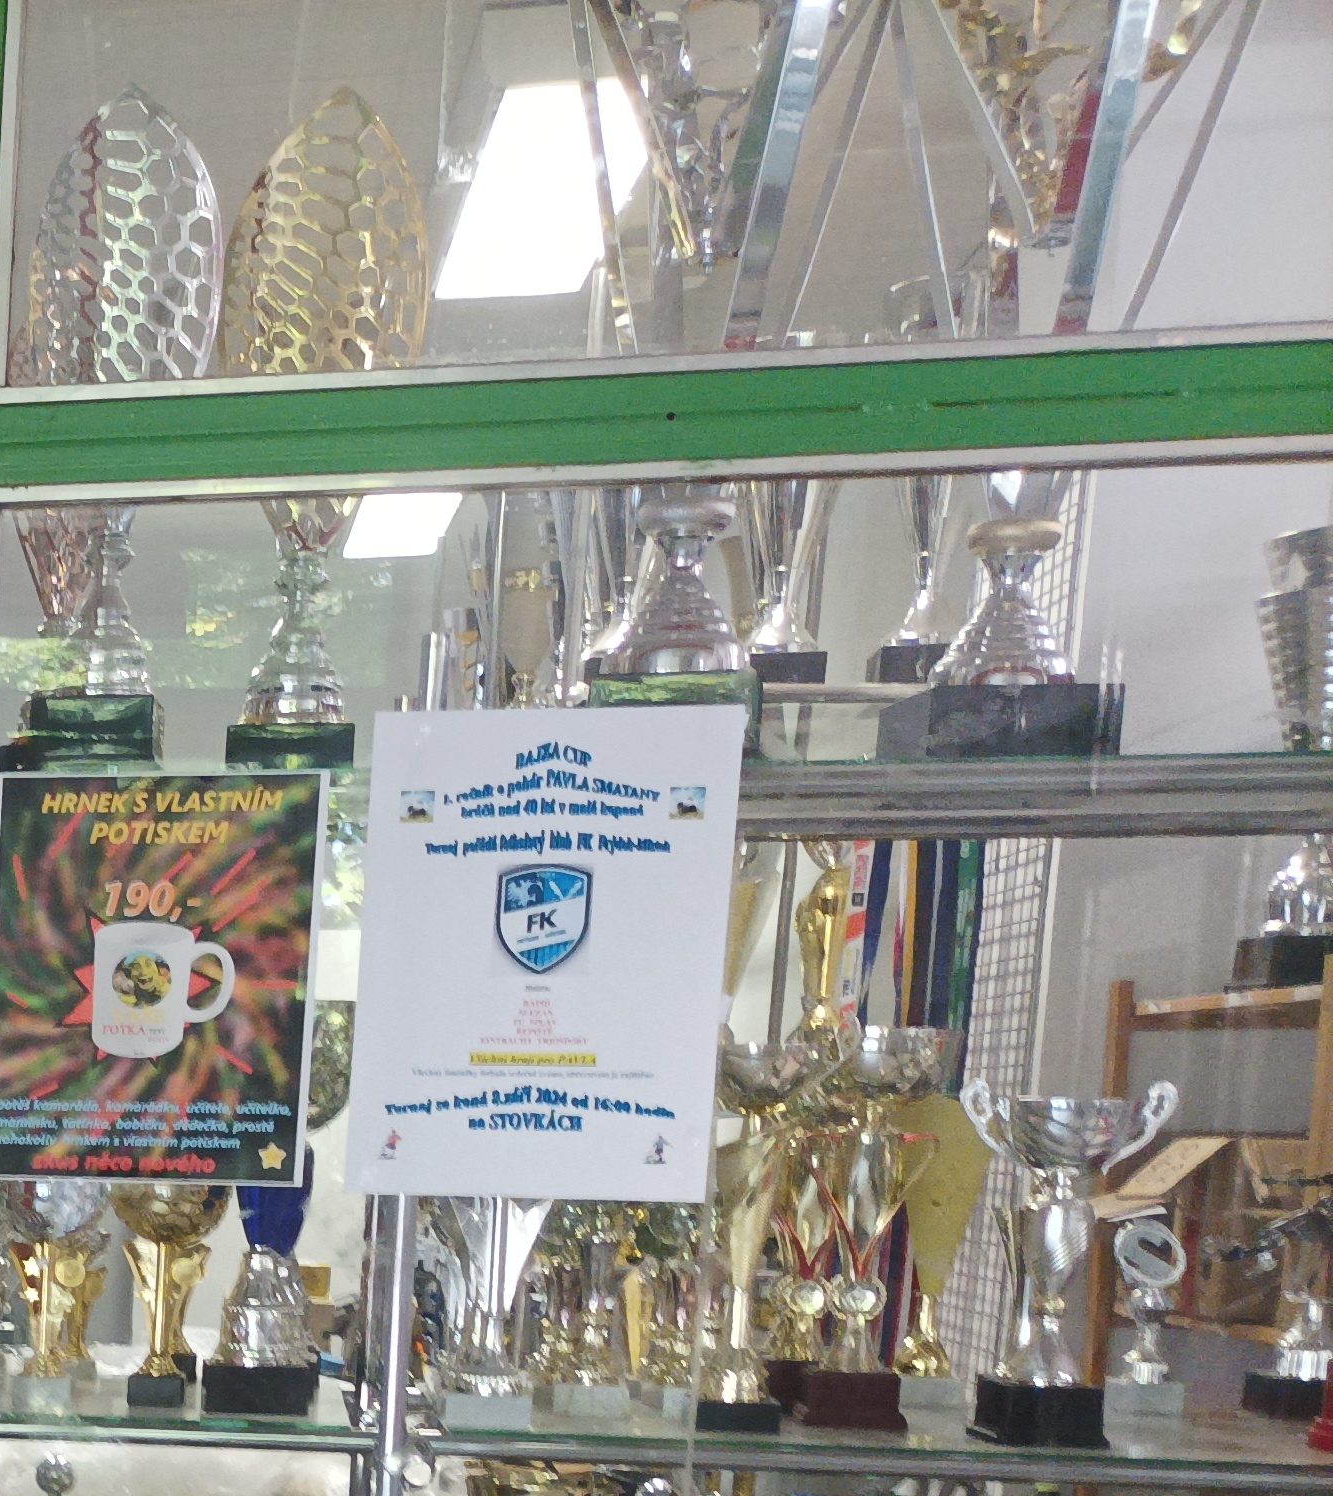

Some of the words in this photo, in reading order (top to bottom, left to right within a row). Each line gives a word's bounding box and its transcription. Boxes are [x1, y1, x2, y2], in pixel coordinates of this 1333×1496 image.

[563, 745, 592, 768] CUP
[546, 769, 590, 792] PAVLA
[41, 791, 127, 814] HRNEK
[134, 791, 148, 814] S
[155, 784, 284, 813] VLASTNÍM
[89, 820, 230, 845] POTISKEM
[104, 879, 202, 923] 190,-
[527, 909, 558, 934] FK
[488, 1109, 583, 1131] STOVKÁCH
